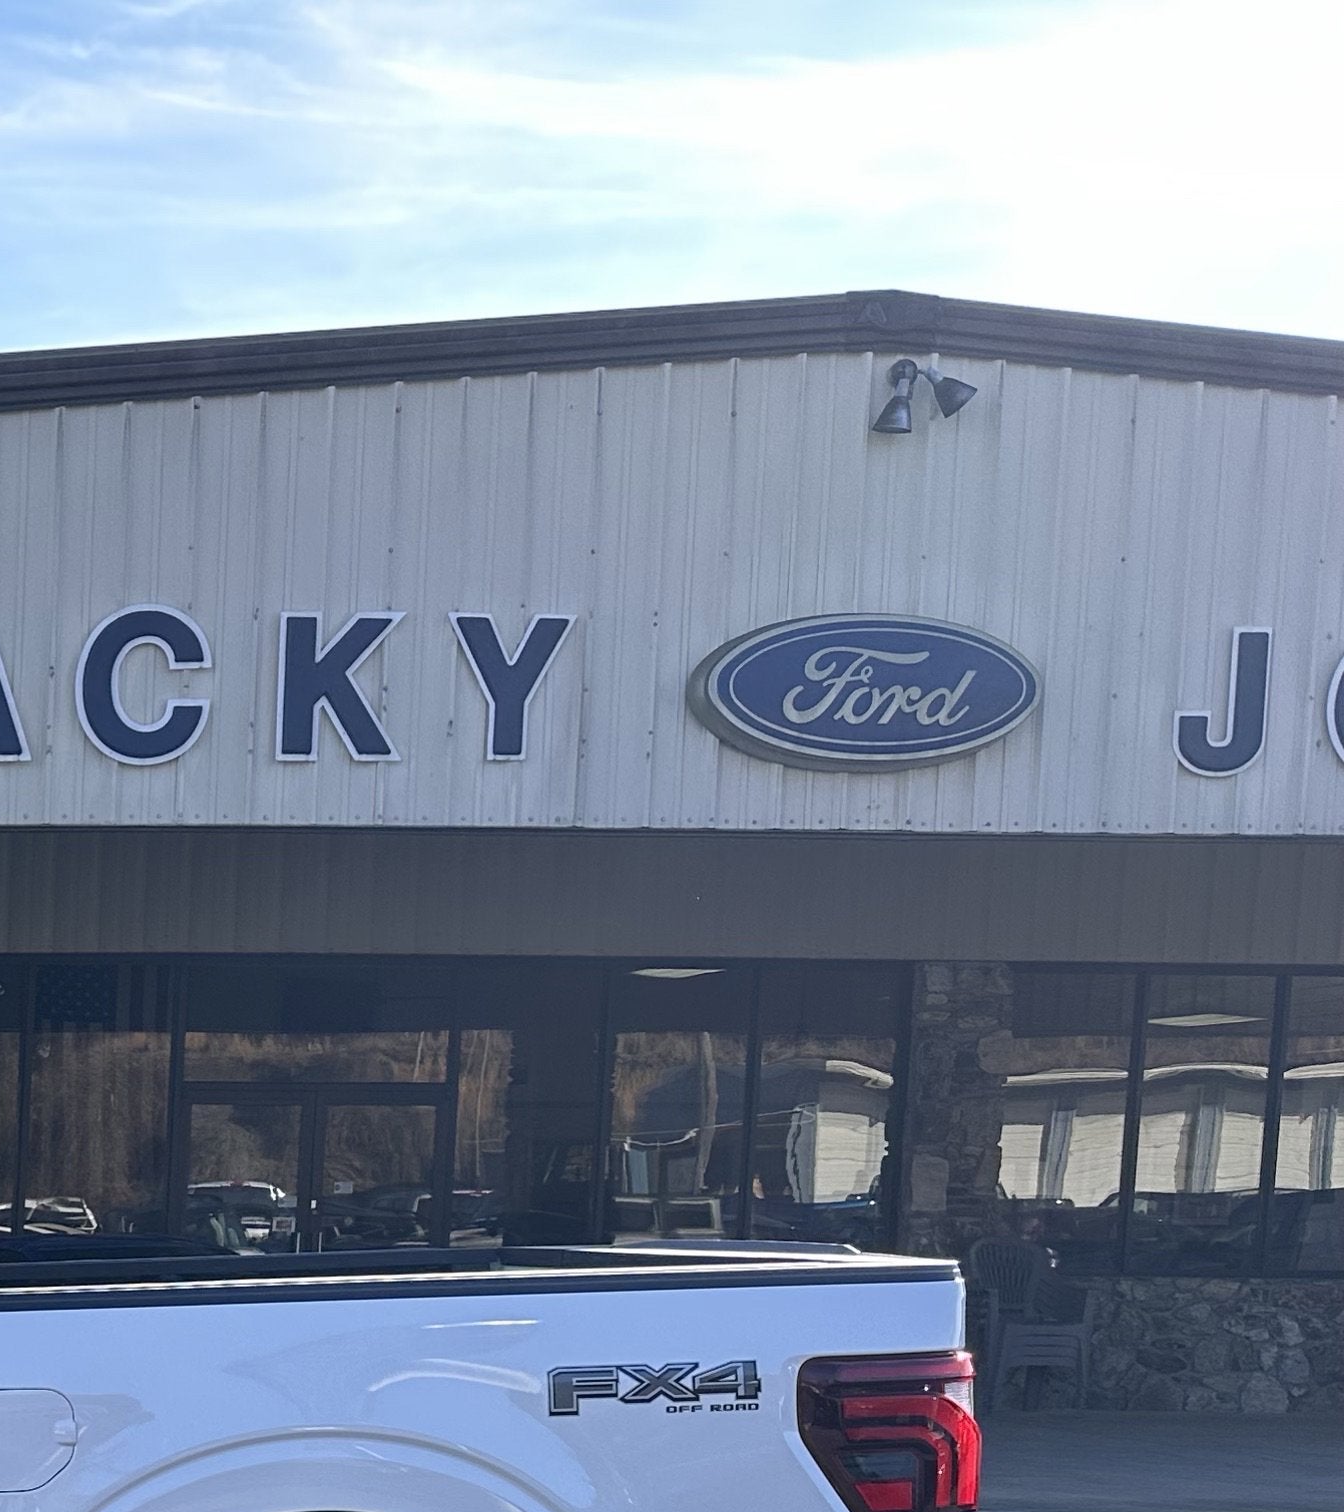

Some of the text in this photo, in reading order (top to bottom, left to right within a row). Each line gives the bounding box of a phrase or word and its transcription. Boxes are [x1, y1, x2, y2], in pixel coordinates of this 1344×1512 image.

[782, 646, 976, 726] Ford
[1173, 626, 1344, 778] J
[547, 1360, 761, 1416] FX4
[666, 1403, 759, 1413] OFF ROAD
